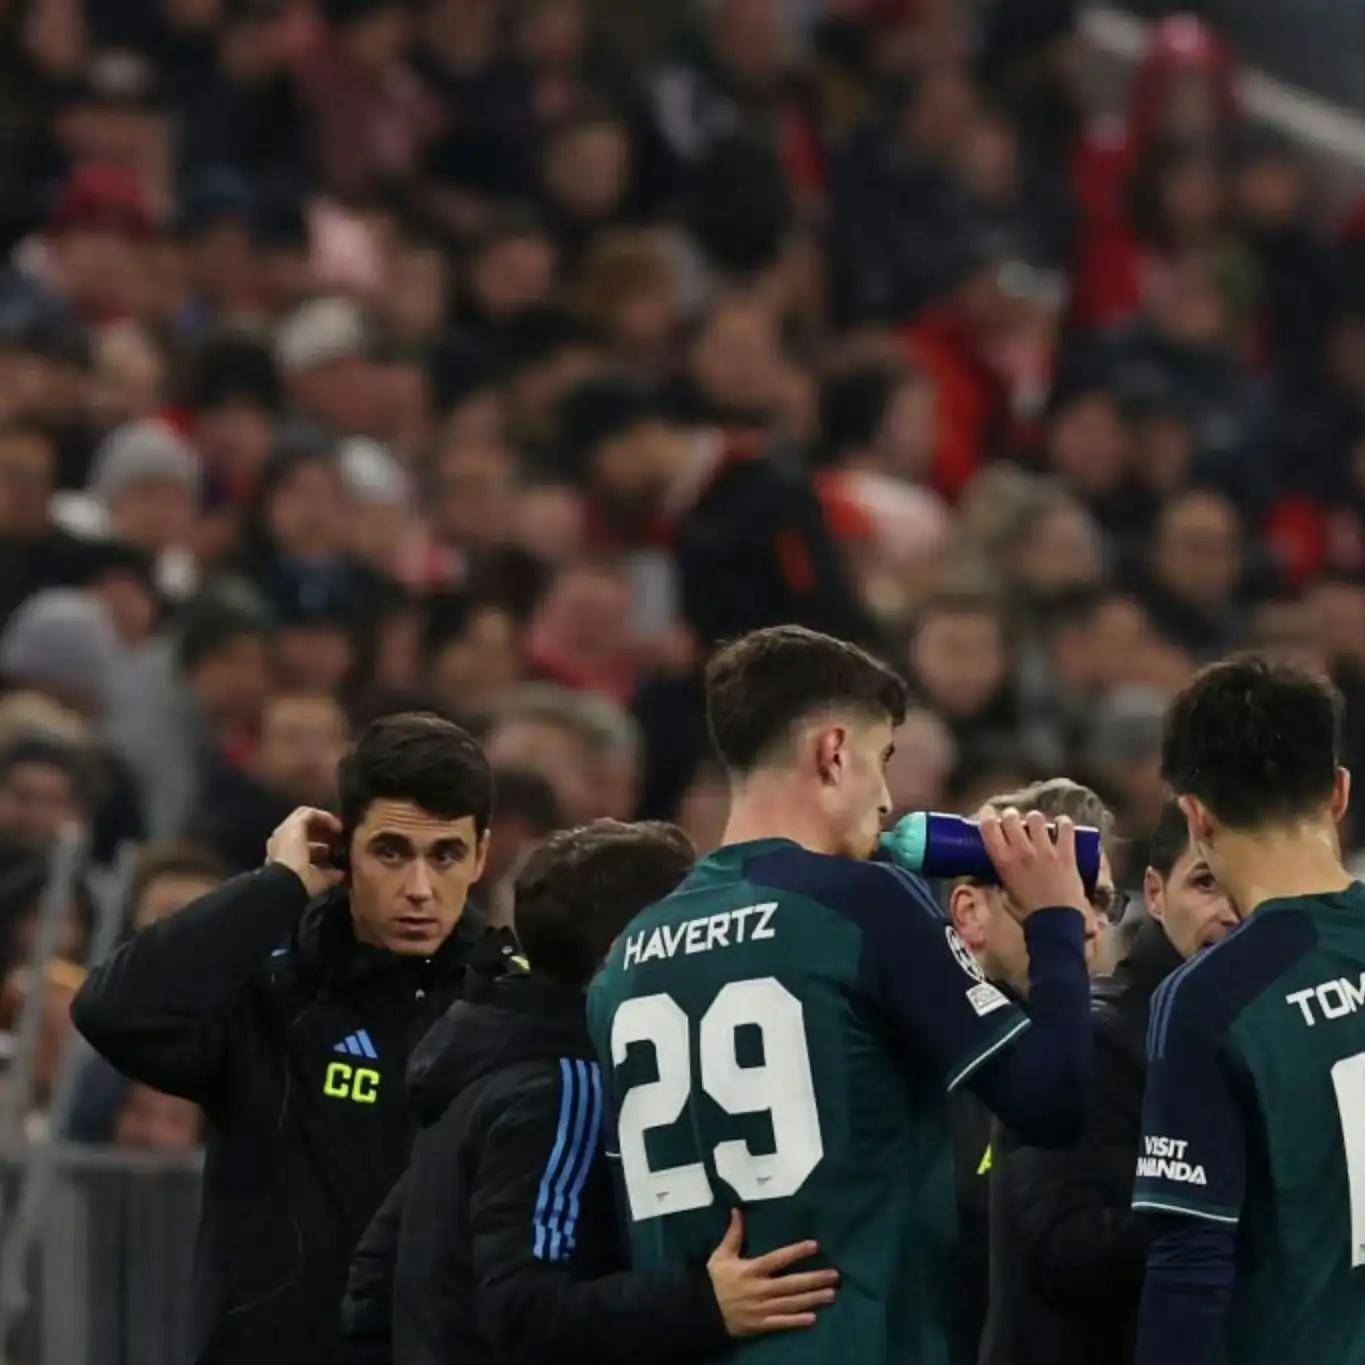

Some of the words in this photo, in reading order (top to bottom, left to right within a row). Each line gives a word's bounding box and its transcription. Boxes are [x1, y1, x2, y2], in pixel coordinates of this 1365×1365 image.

[622, 902, 779, 970] HAVERTZ
[324, 1062, 380, 1104] CC
[610, 976, 825, 1223] 29
[1144, 1135, 1189, 1160] VISIT
